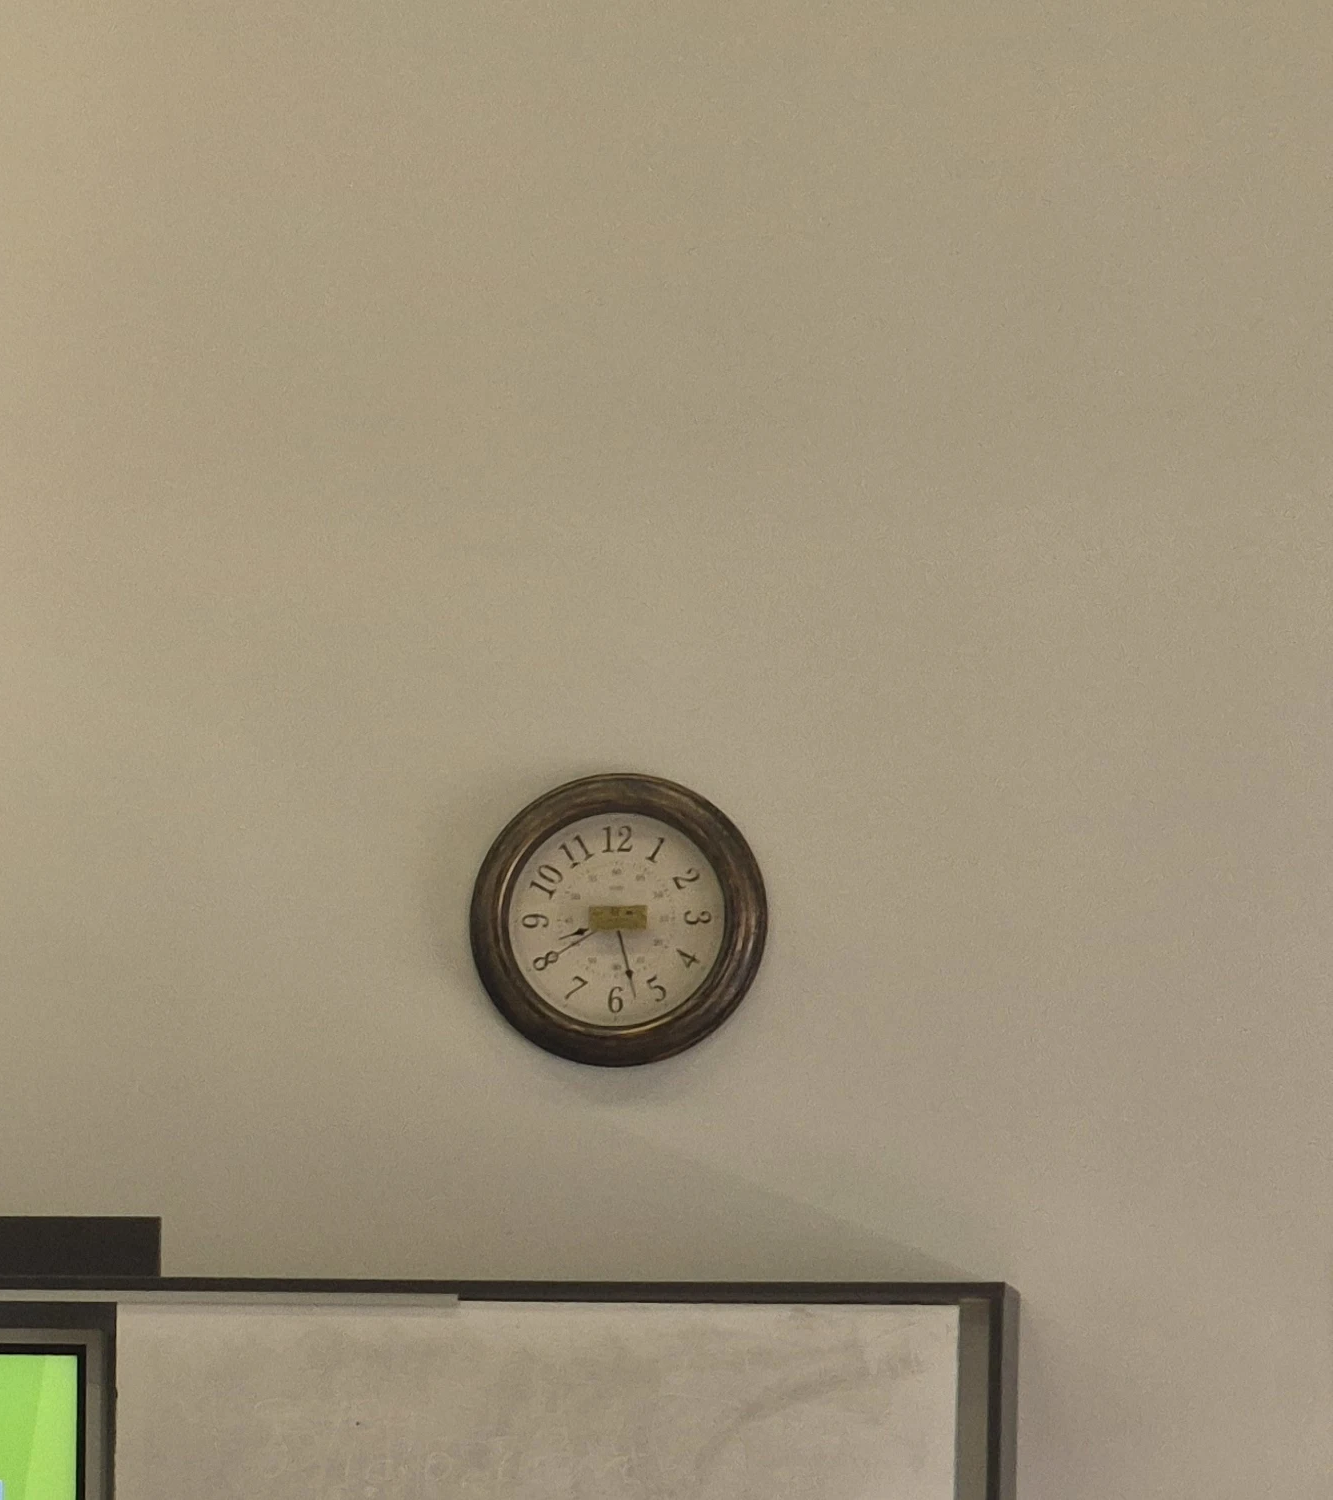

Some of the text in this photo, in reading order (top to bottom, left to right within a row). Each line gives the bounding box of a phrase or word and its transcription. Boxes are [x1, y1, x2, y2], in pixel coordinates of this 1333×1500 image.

[558, 835, 595, 869] 11
[601, 825, 633, 853] 12
[645, 837, 665, 864] 1
[529, 864, 564, 900] 10
[672, 867, 701, 890] 2
[521, 912, 550, 930] 9
[684, 909, 712, 926] 3
[532, 950, 559, 972] 8
[675, 947, 701, 970] 4
[564, 975, 589, 1000] 7
[607, 986, 624, 1014] 6
[646, 975, 667, 1002] 5
